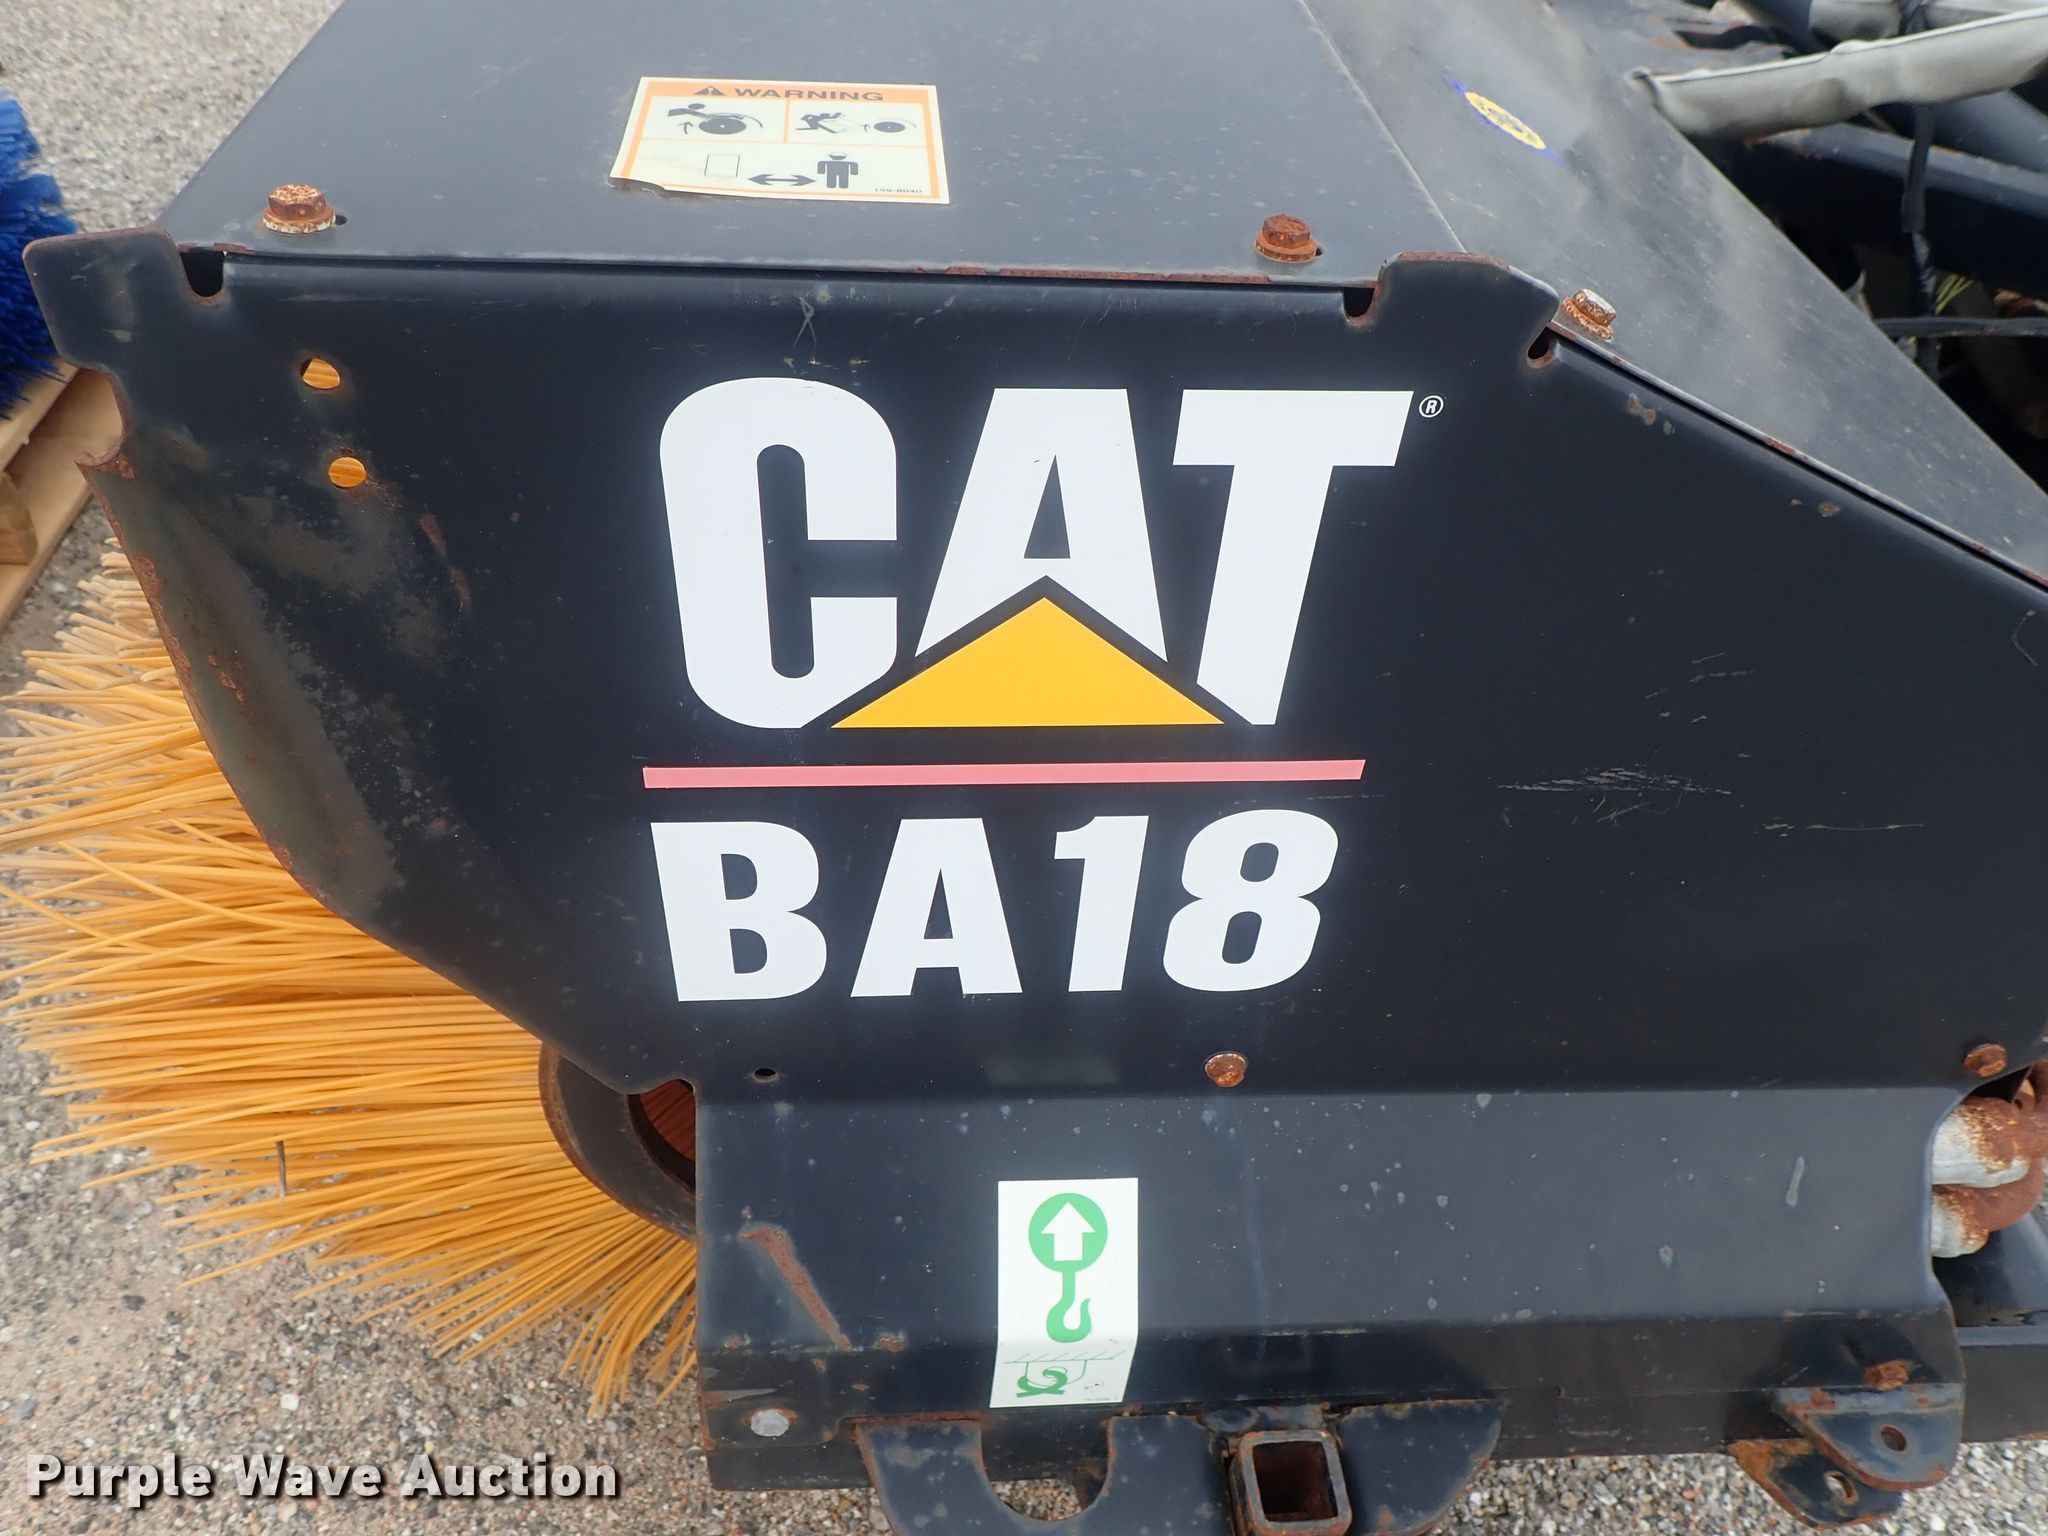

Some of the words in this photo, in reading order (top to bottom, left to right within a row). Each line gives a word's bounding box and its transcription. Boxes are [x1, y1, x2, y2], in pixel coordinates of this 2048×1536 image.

[734, 87, 884, 102] WARNING
[660, 378, 1414, 729] CAT
[651, 810, 1339, 1002] BA18
